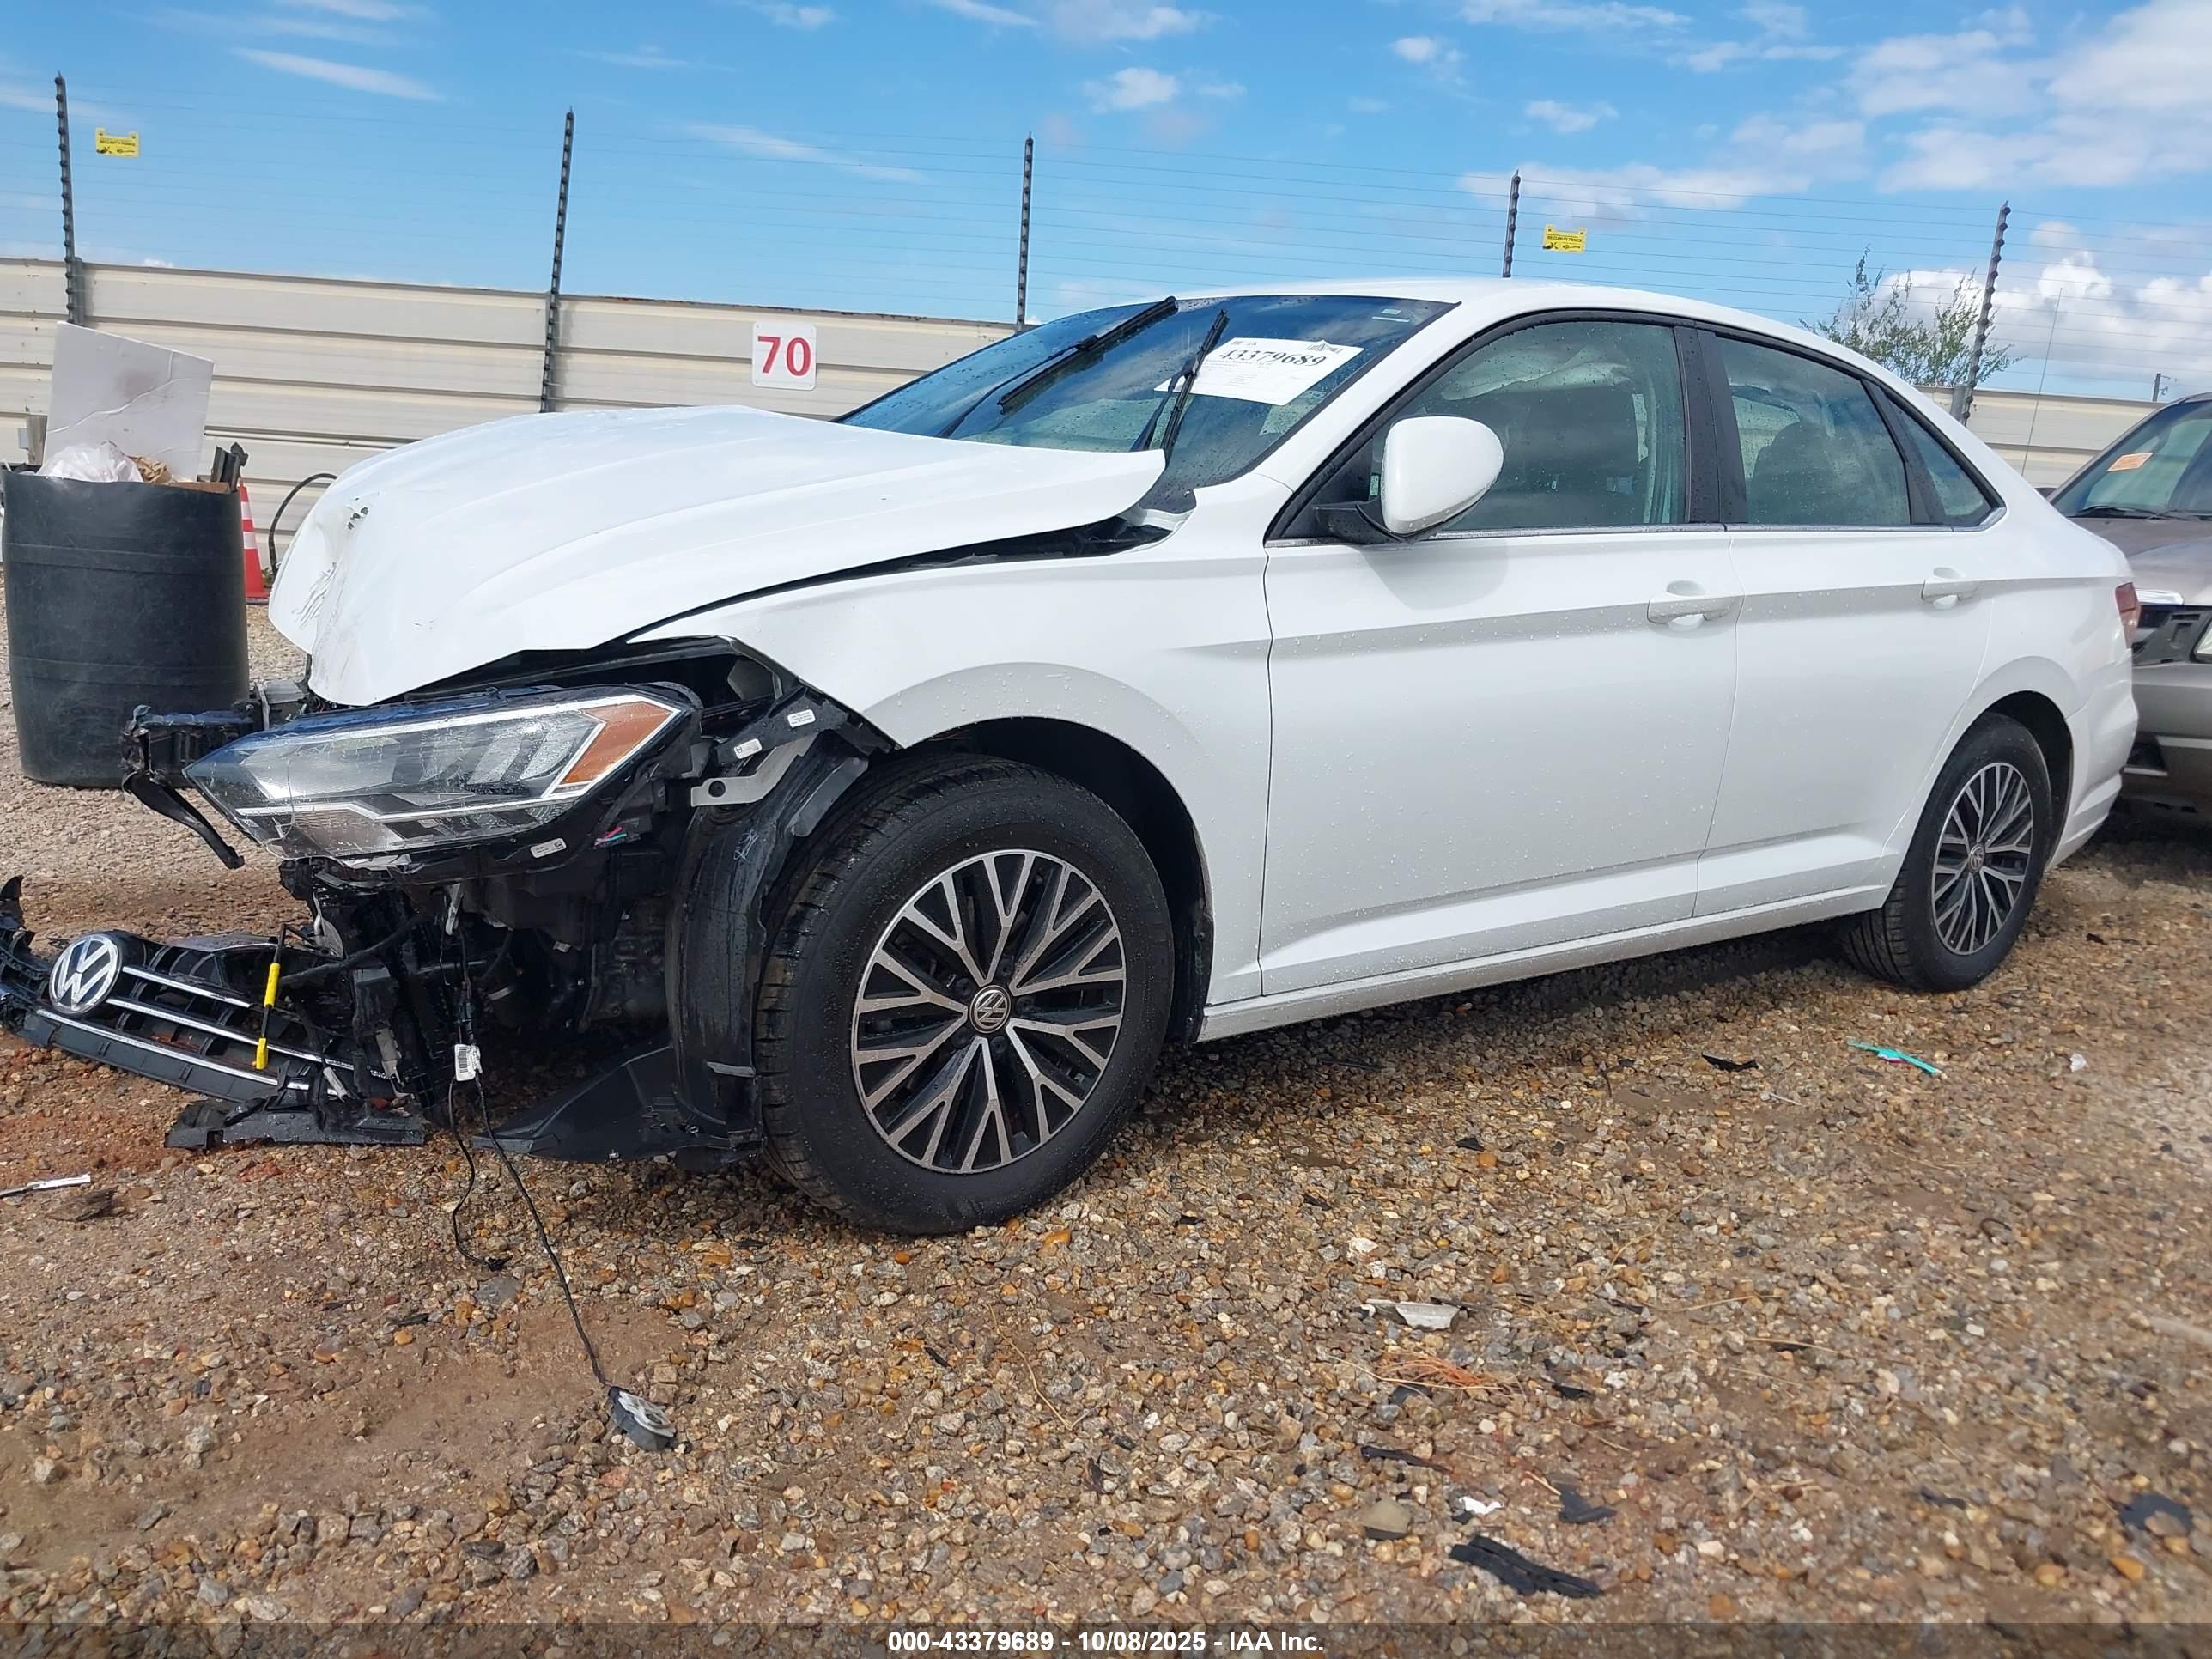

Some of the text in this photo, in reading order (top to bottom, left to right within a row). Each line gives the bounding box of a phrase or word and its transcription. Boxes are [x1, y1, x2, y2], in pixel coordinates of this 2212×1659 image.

[757, 336, 811, 376] 70
[1219, 349, 1327, 367] 43379689
[51, 934, 119, 1014] VW
